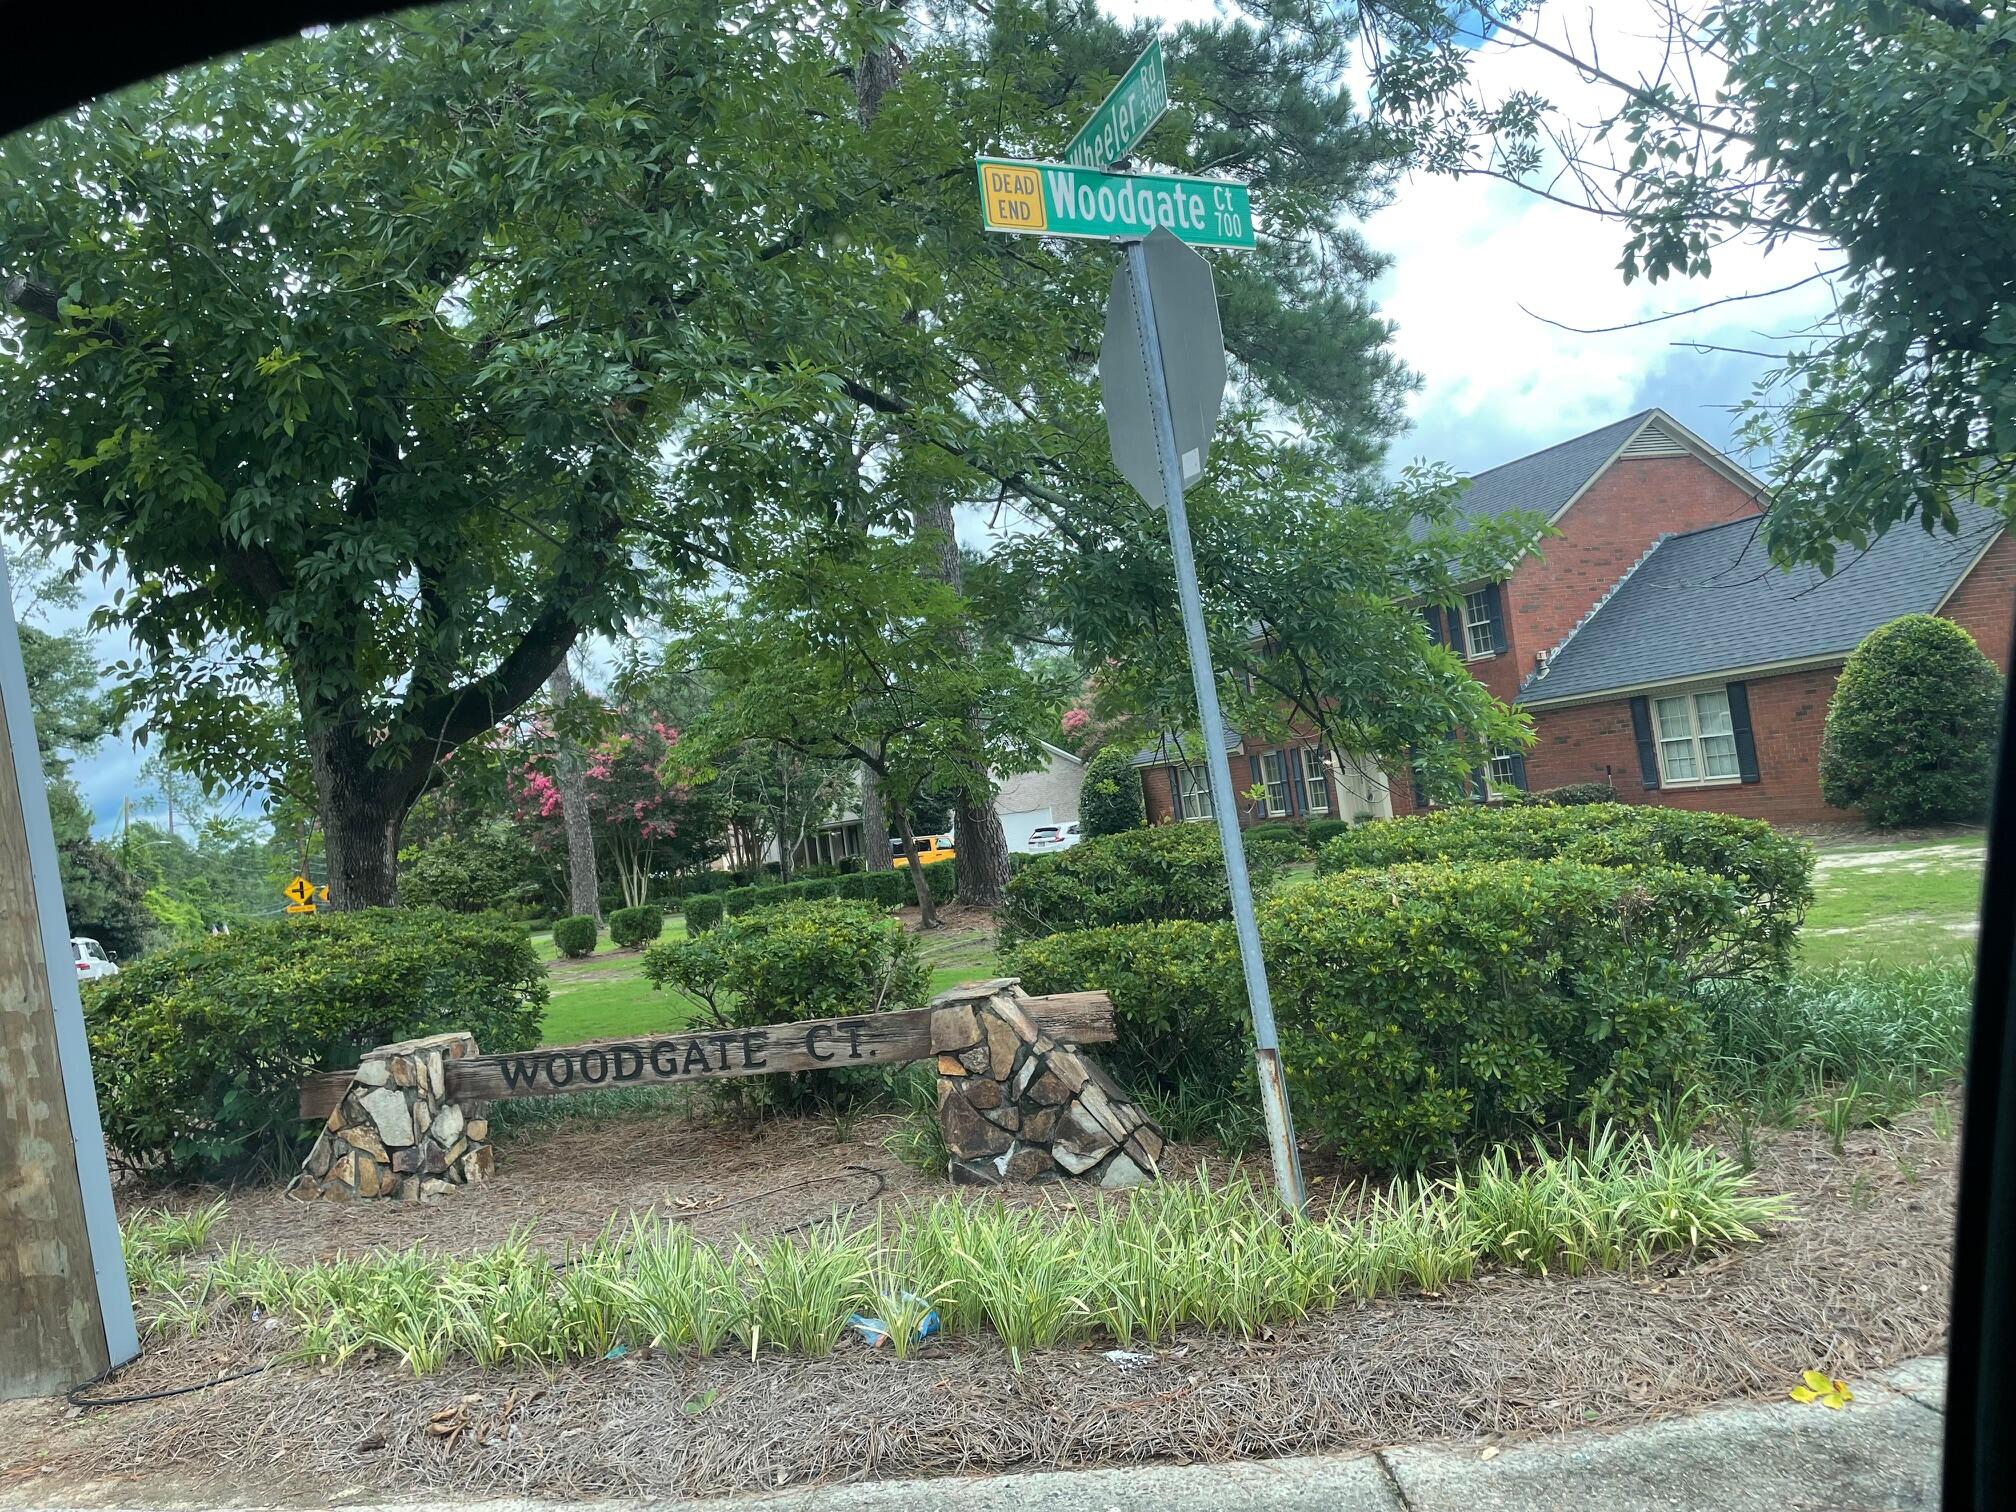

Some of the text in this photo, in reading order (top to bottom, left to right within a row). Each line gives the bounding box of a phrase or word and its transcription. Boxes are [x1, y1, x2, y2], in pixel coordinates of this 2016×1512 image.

[1140, 56, 1156, 94] Rd
[1140, 80, 1165, 126] 3300
[992, 172, 1034, 196] DEAD
[1047, 170, 1234, 230] Woodgate Ct
[999, 200, 1031, 221] END
[1214, 214, 1242, 237] 700
[499, 1020, 878, 1090] WOODGATE CT.
